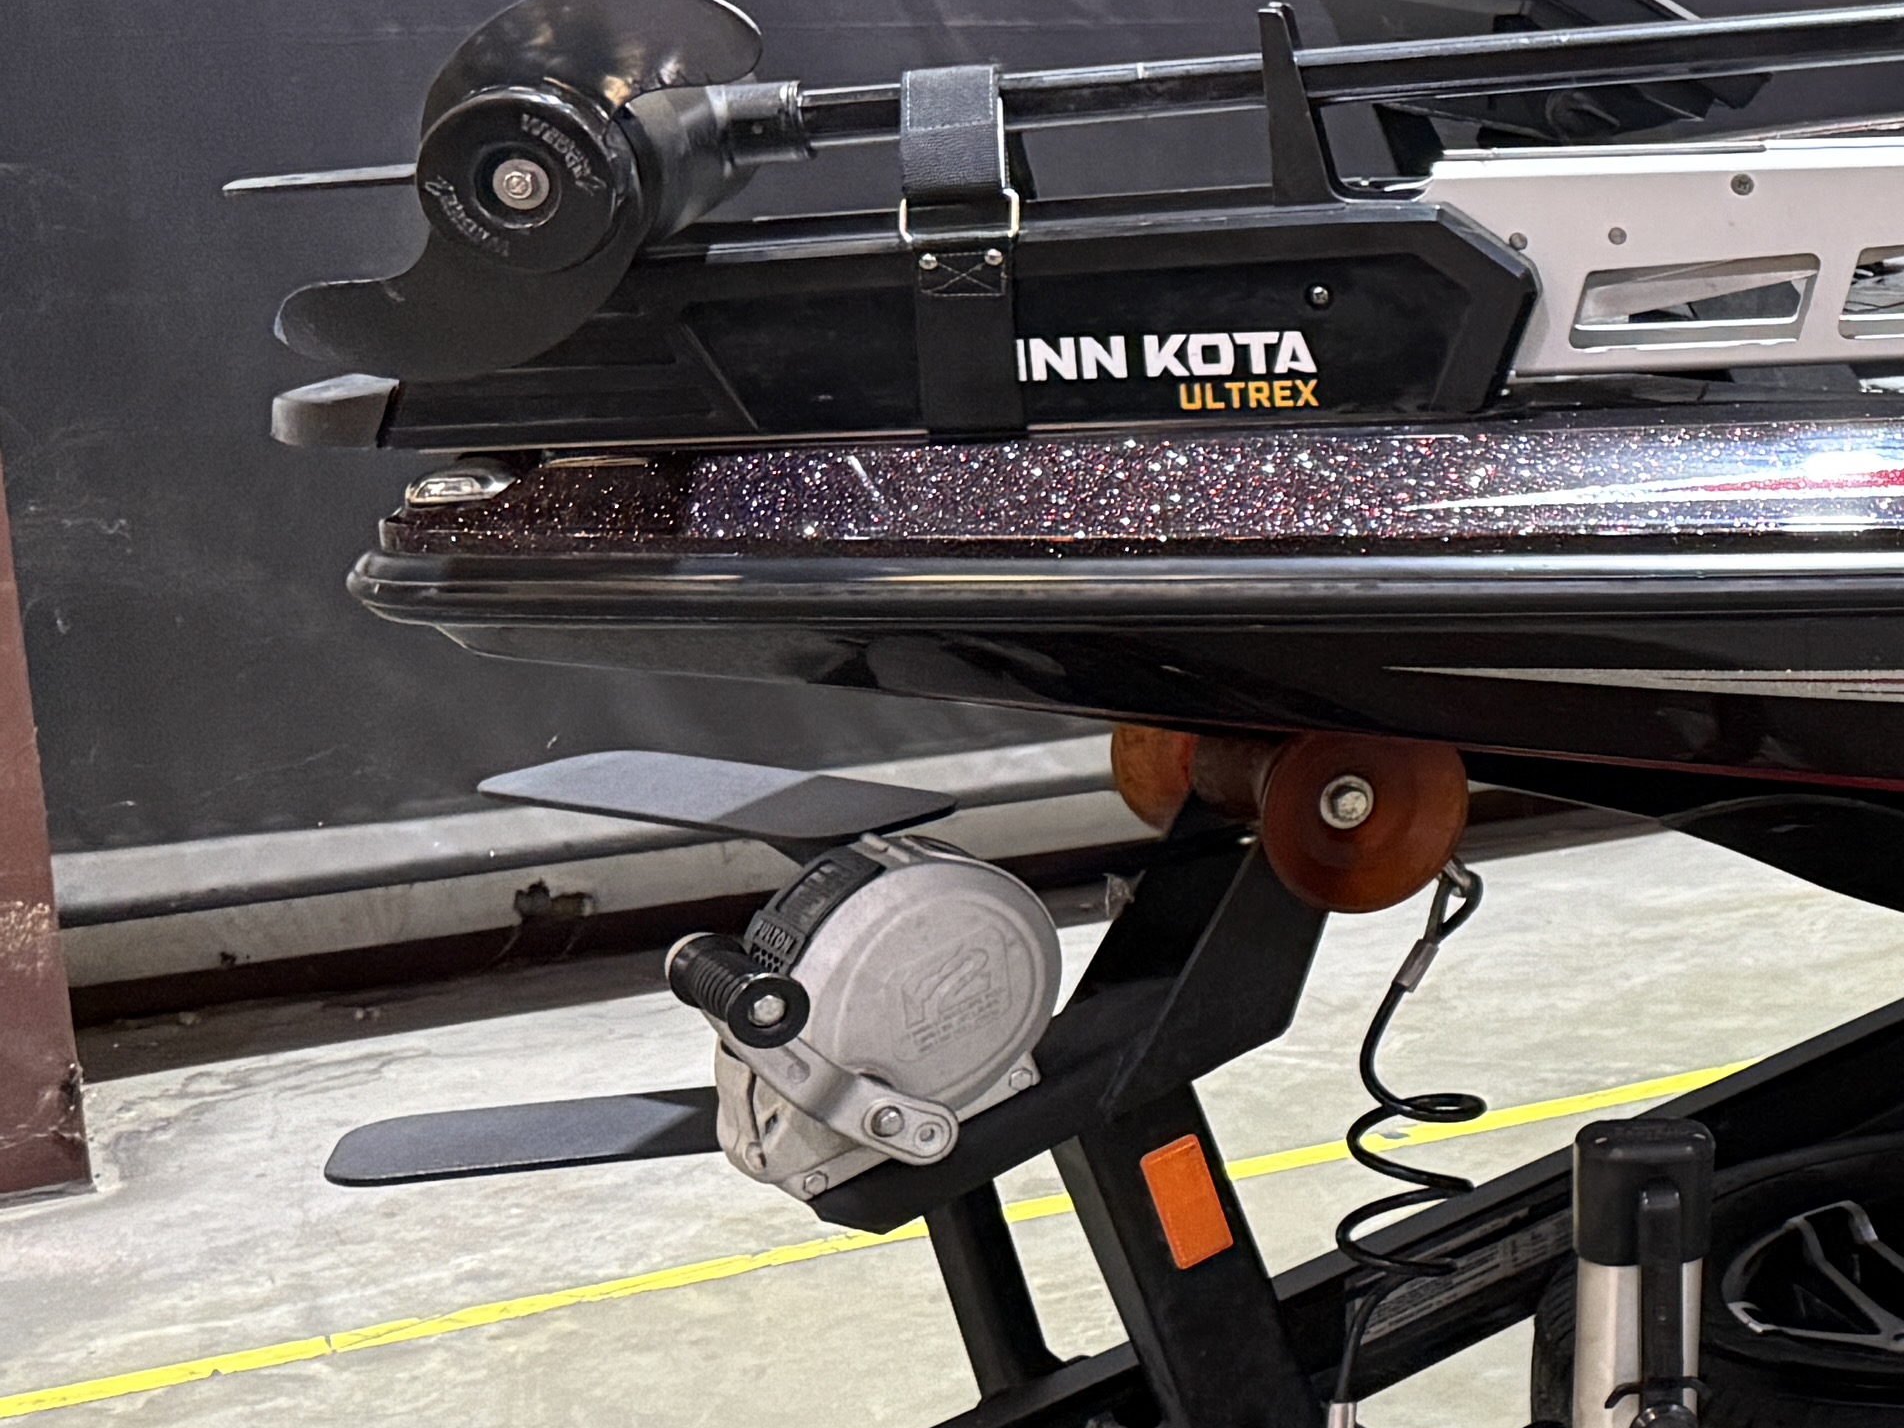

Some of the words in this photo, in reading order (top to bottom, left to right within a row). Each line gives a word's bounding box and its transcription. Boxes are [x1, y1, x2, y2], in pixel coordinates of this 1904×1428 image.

[1015, 335, 1128, 382] INN
[1143, 331, 1318, 377] KOTA
[1179, 380, 1320, 409] ULTREX
